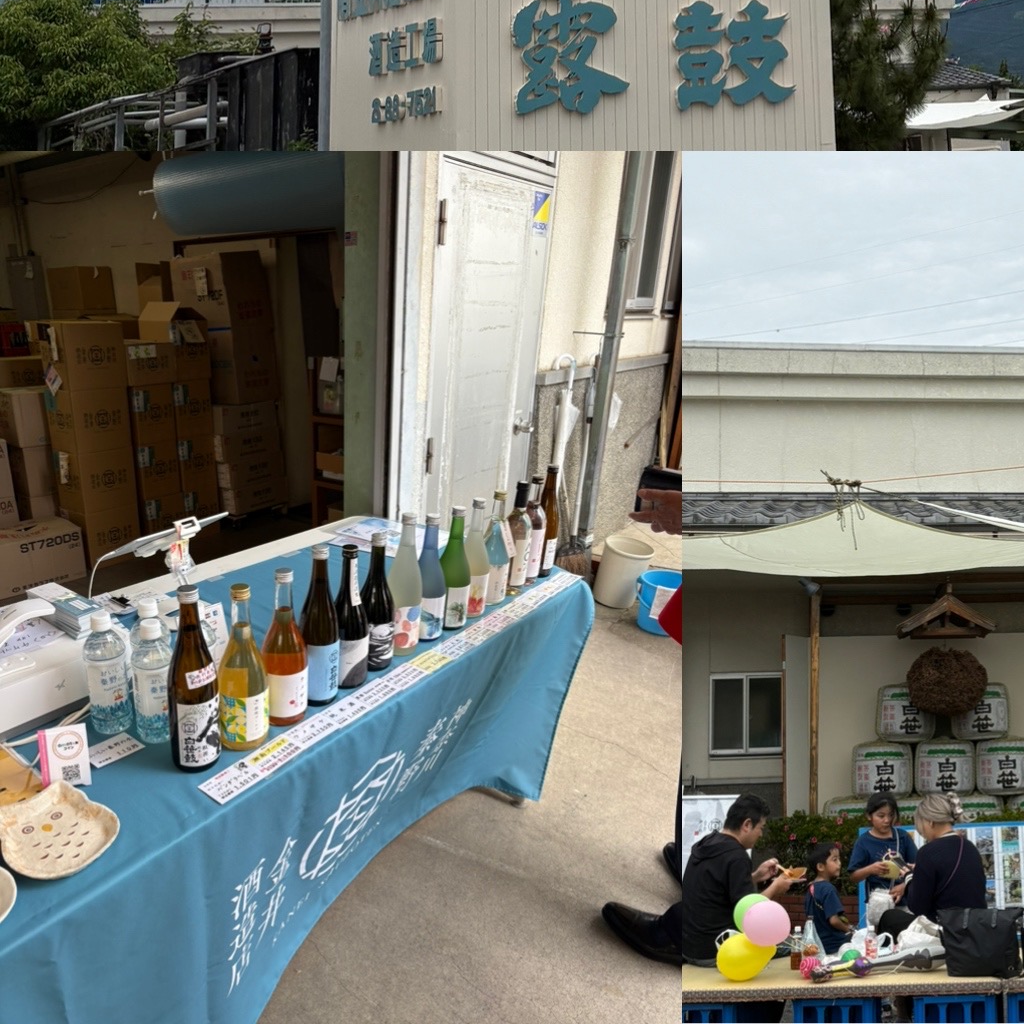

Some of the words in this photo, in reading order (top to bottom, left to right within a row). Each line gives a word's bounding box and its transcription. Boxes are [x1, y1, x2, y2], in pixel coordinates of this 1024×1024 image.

[369, 18, 443, 76] 酒造工場
[20, 532, 80, 553] ST720DS
[227, 858, 267, 999] 酒造店
[256, 836, 298, 950] 金井
